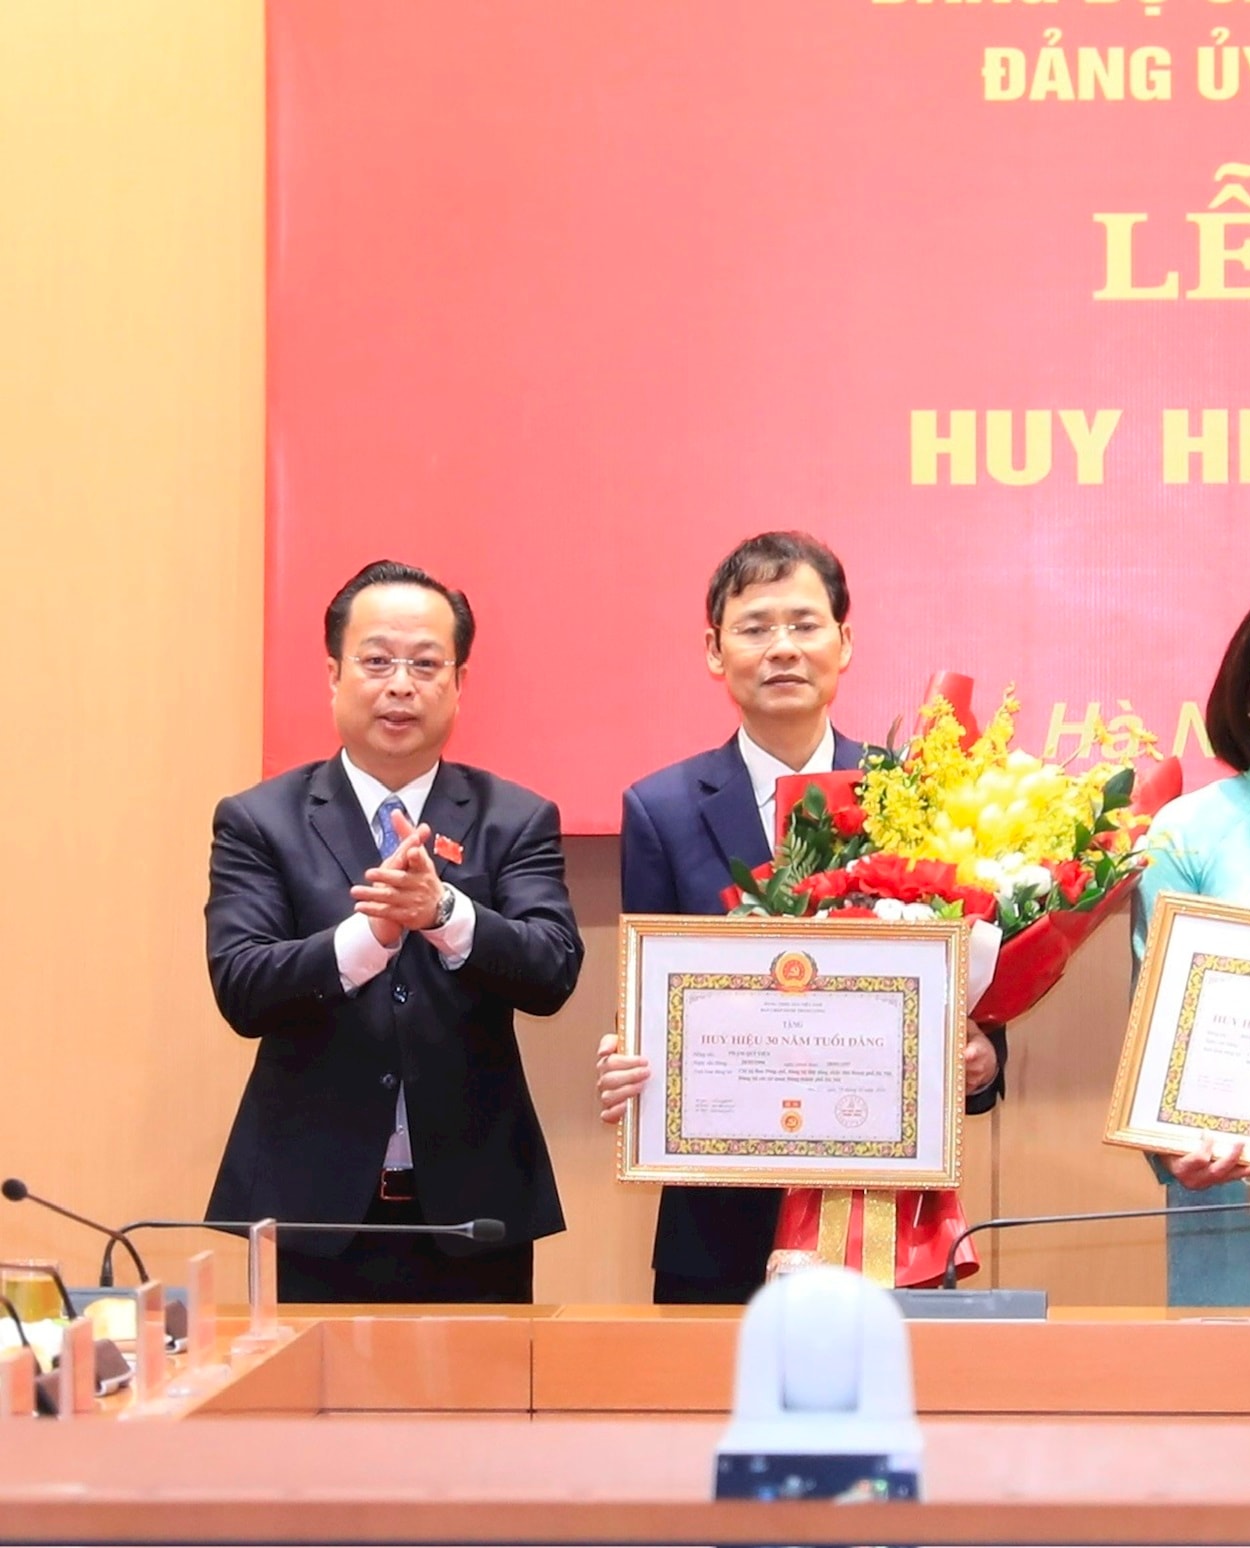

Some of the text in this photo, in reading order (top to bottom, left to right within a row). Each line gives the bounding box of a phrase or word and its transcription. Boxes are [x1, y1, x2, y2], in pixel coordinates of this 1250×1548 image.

[982, 28, 1172, 101] ĐẢNG
[910, 409, 1123, 486] HUY
[701, 1034, 728, 1045] HUY
